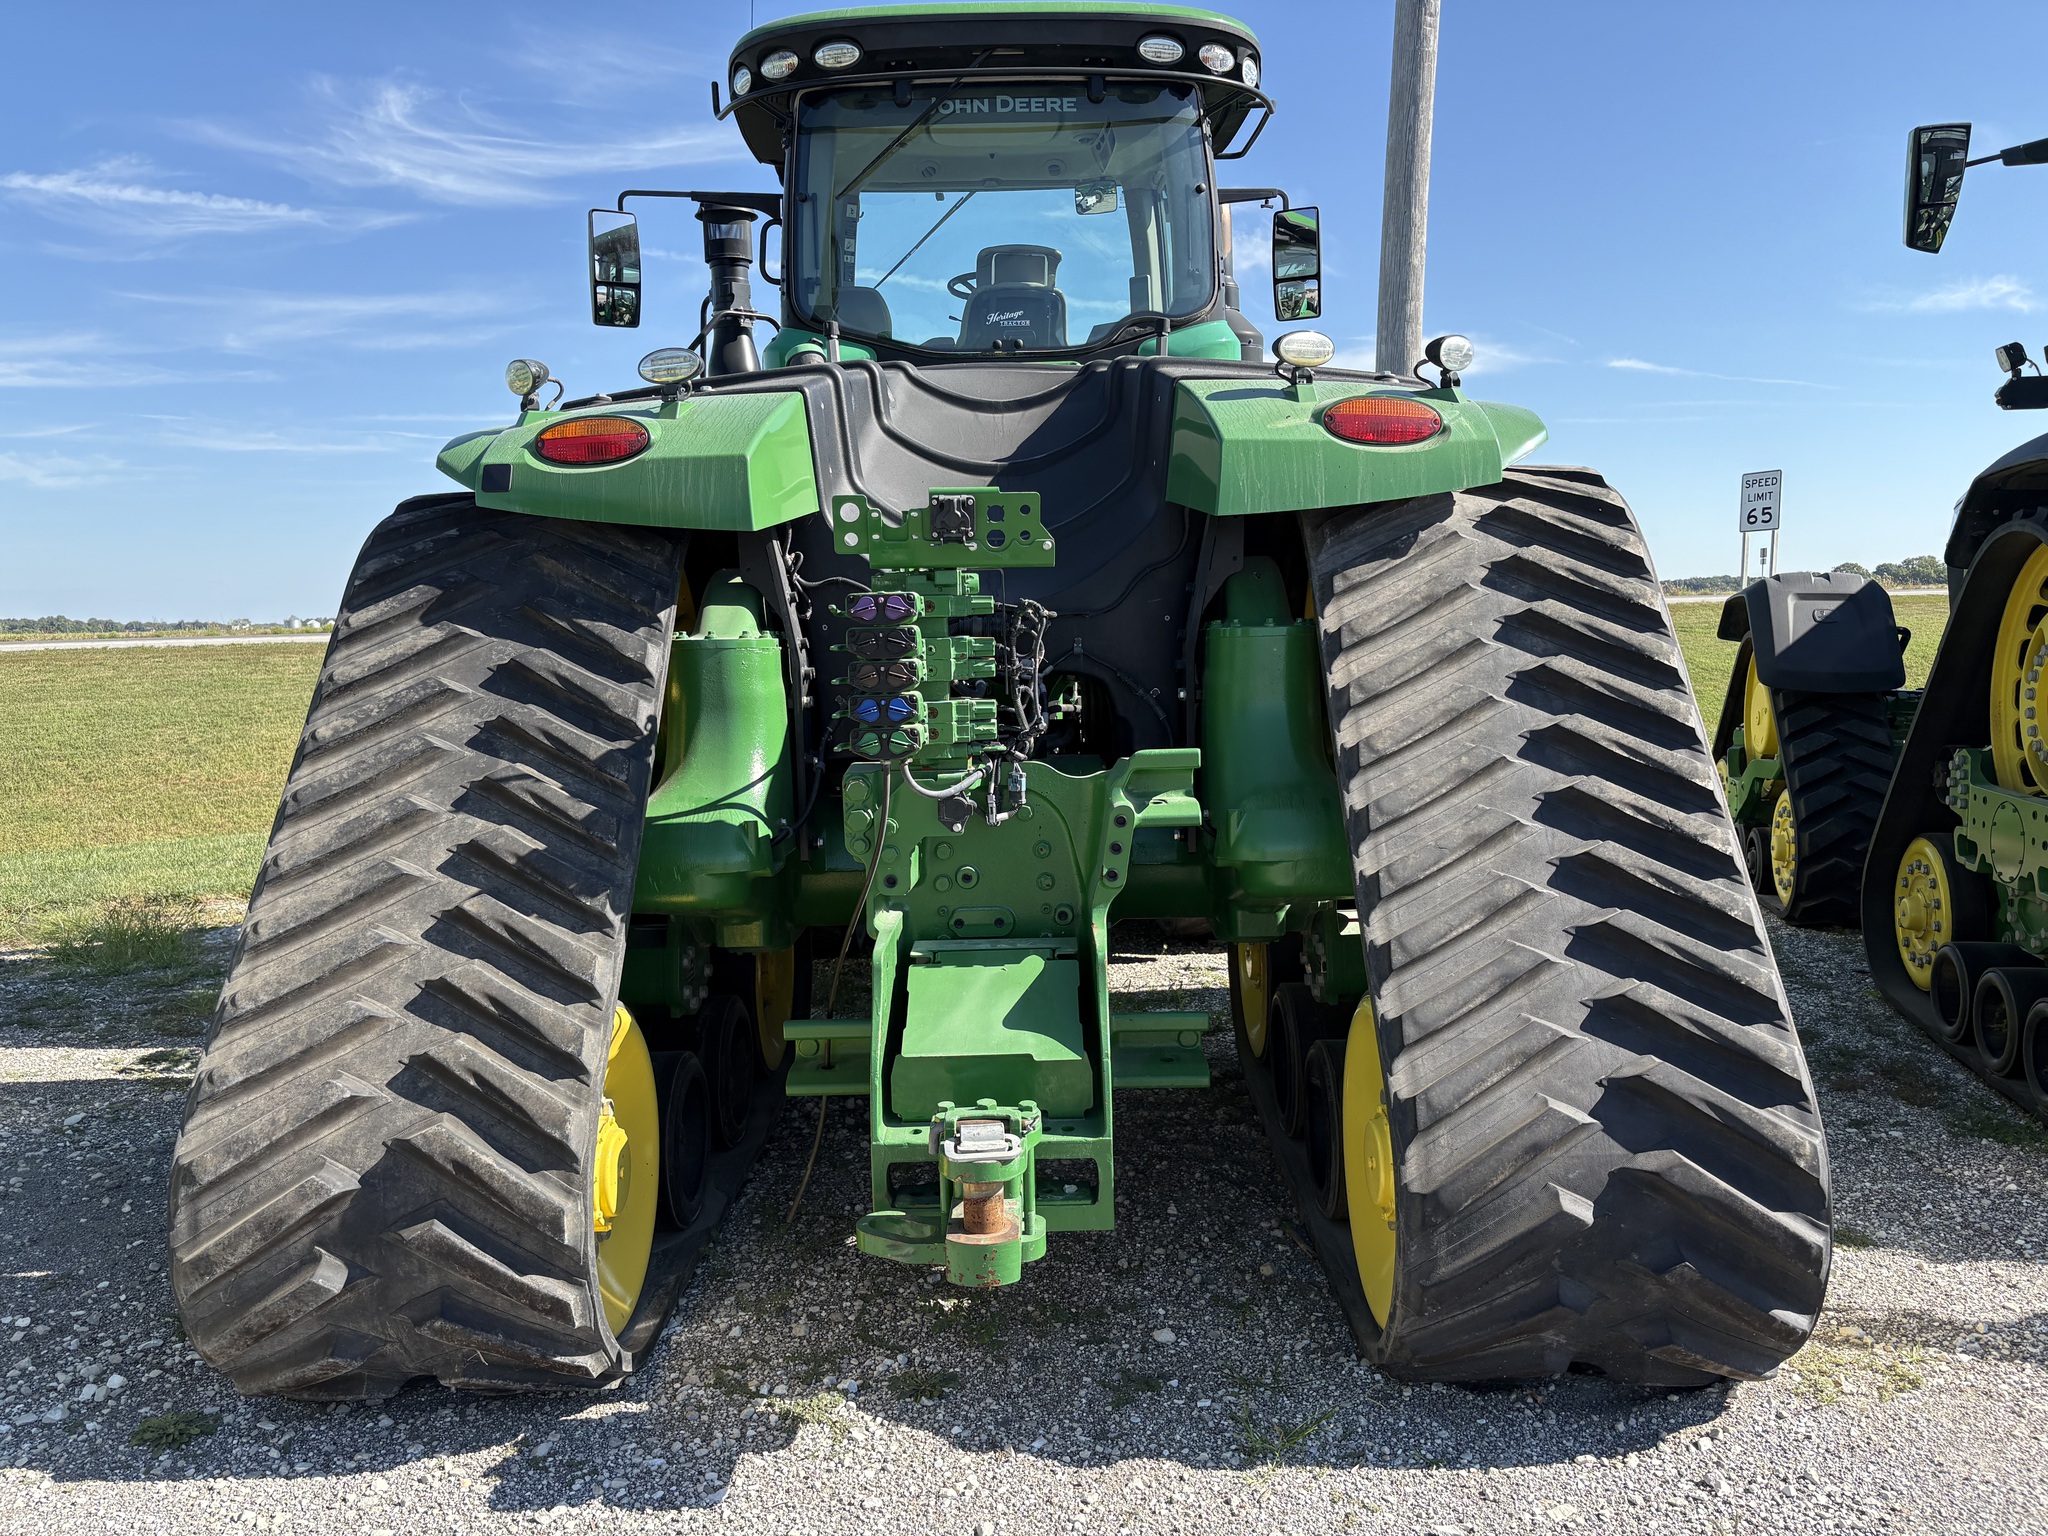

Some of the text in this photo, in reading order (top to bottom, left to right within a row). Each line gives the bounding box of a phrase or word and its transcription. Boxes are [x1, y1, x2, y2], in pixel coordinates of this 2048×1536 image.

[996, 95, 1077, 113] DEERE
[986, 310, 1024, 325] Heritage
[1745, 477, 1778, 489] SPEED
[1747, 491, 1773, 502] LIMIT
[1746, 506, 1773, 525] 65
